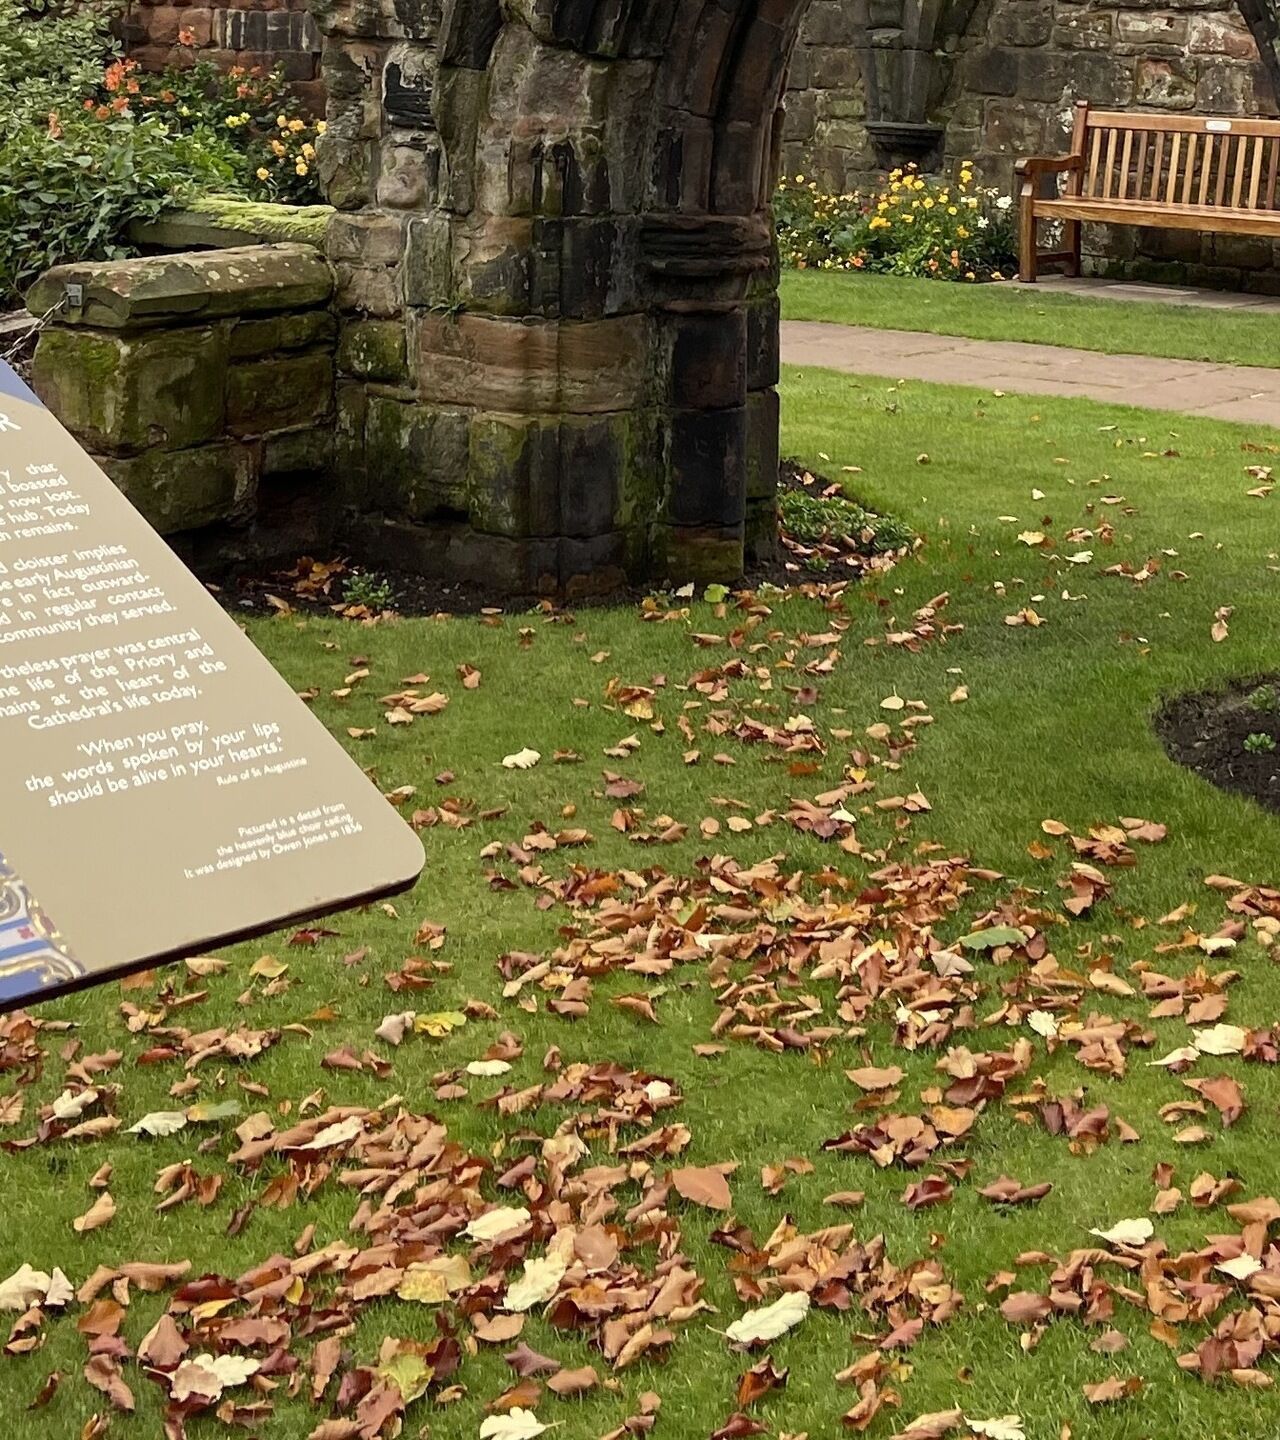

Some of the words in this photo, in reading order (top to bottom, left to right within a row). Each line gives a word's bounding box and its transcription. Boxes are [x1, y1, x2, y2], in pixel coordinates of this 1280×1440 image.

[25, 462, 58, 475] that
[8, 475, 68, 492] boasted
[8, 496, 41, 508] now
[46, 489, 82, 503] lost.
[9, 510, 44, 523] hub.
[42, 503, 90, 517] Today
[14, 521, 79, 539] remains.
[13, 554, 69, 572] cloister
[73, 543, 127, 561] implies
[14, 572, 51, 588] early
[53, 558, 139, 582] Augustinian
[17, 608, 37, 622] in
[43, 598, 97, 617] regular
[107, 586, 165, 605] contact
[19, 593, 37, 605] in
[42, 584, 75, 600] fact
[84, 612, 118, 627] they
[121, 601, 177, 618] served.
[59, 648, 112, 667] prayer
[113, 641, 146, 654] was
[147, 628, 201, 648] central
[26, 678, 55, 692] life
[64, 672, 82, 685] of
[90, 665, 119, 680] the
[124, 653, 176, 672] Priory
[184, 643, 214, 659] and
[51, 694, 71, 705] at
[79, 685, 109, 700] the
[118, 673, 164, 692] heart
[173, 666, 190, 680] of
[198, 660, 227, 674] the
[124, 694, 151, 710] life
[152, 685, 203, 702] today.
[137, 729, 167, 746] you
[25, 775, 54, 791] the
[61, 760, 115, 782] words
[122, 747, 178, 770] spoken
[184, 739, 205, 755] by
[212, 730, 246, 750] your
[252, 721, 280, 737] lips
[48, 782, 103, 807] should
[107, 778, 128, 793] be
[132, 769, 168, 787] alive
[170, 764, 187, 777] in
[190, 754, 225, 776] your
[216, 775, 239, 786] Rule
[240, 771, 250, 780] of
[263, 757, 307, 774] Augustine
[238, 819, 278, 837] Pictured
[279, 816, 288, 825] is
[289, 816, 295, 824] a
[296, 808, 321, 821] detail
[322, 802, 345, 814] from
[183, 868, 194, 879] It
[195, 864, 214, 876] was
[216, 852, 257, 870] designed
[258, 849, 271, 859] by
[272, 840, 302, 854] Owen
[303, 833, 328, 849] Jones
[330, 829, 339, 838] in
[216, 845, 234, 856] the
[234, 834, 275, 852] heavenly
[276, 828, 297, 840] blue
